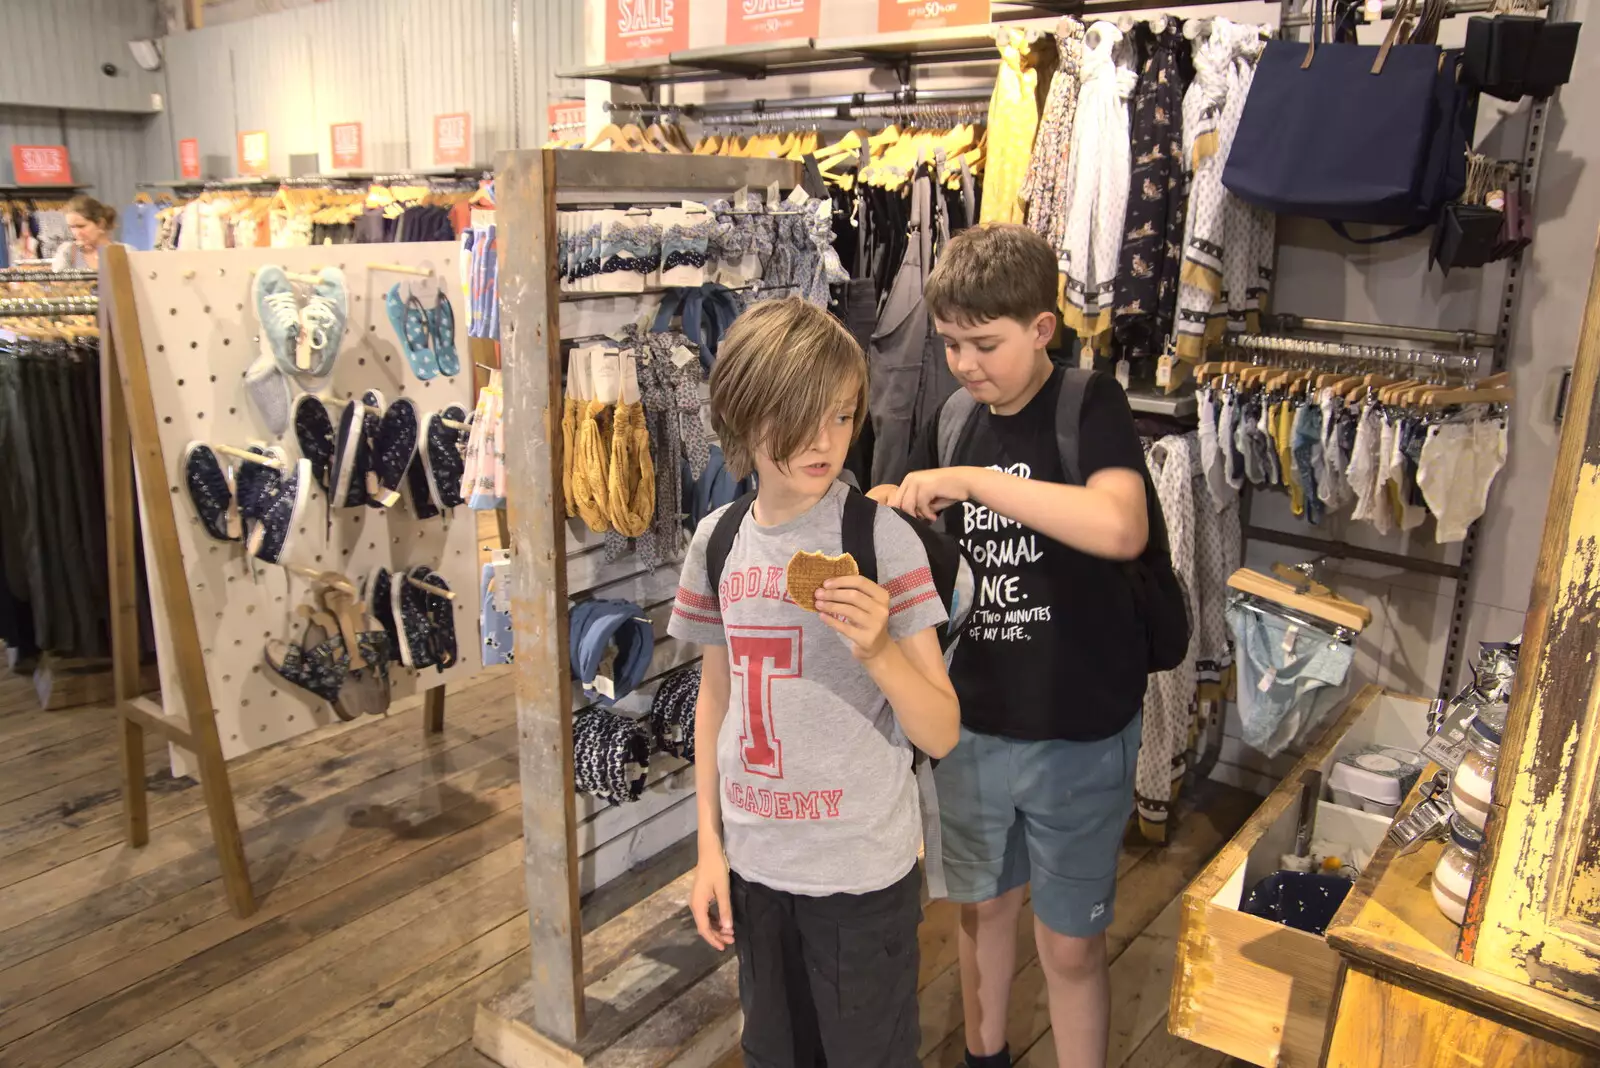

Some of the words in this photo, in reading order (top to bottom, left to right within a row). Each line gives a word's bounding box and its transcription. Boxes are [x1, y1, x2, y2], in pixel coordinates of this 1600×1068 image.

[618, 0, 675, 33] SALE
[962, 501, 1022, 535] BEIN
[980, 610, 1001, 624] TWO
[1004, 606, 1051, 624] MINUTES
[969, 626, 981, 641] OF
[983, 627, 999, 641] MY
[727, 625, 803, 779] T
